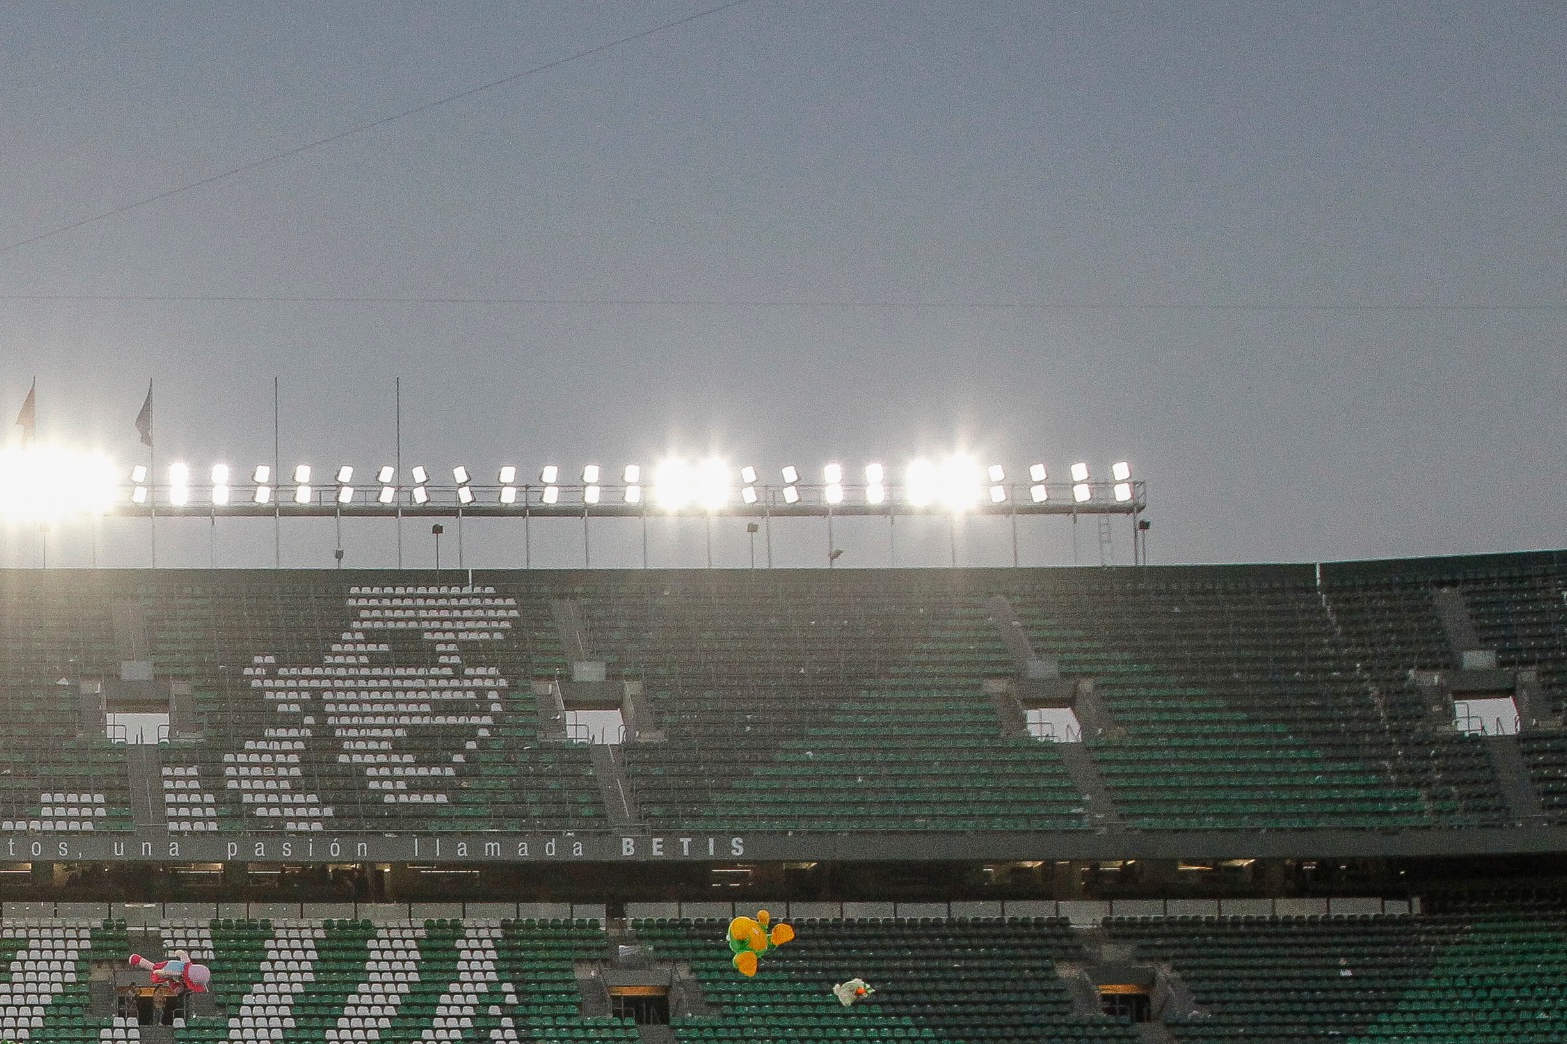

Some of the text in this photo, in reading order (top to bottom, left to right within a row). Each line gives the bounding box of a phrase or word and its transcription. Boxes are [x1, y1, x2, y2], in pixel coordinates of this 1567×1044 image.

[114, 841, 180, 857] una
[227, 838, 368, 860] pasión
[414, 838, 584, 857] llamada
[622, 837, 745, 856] BETIS
